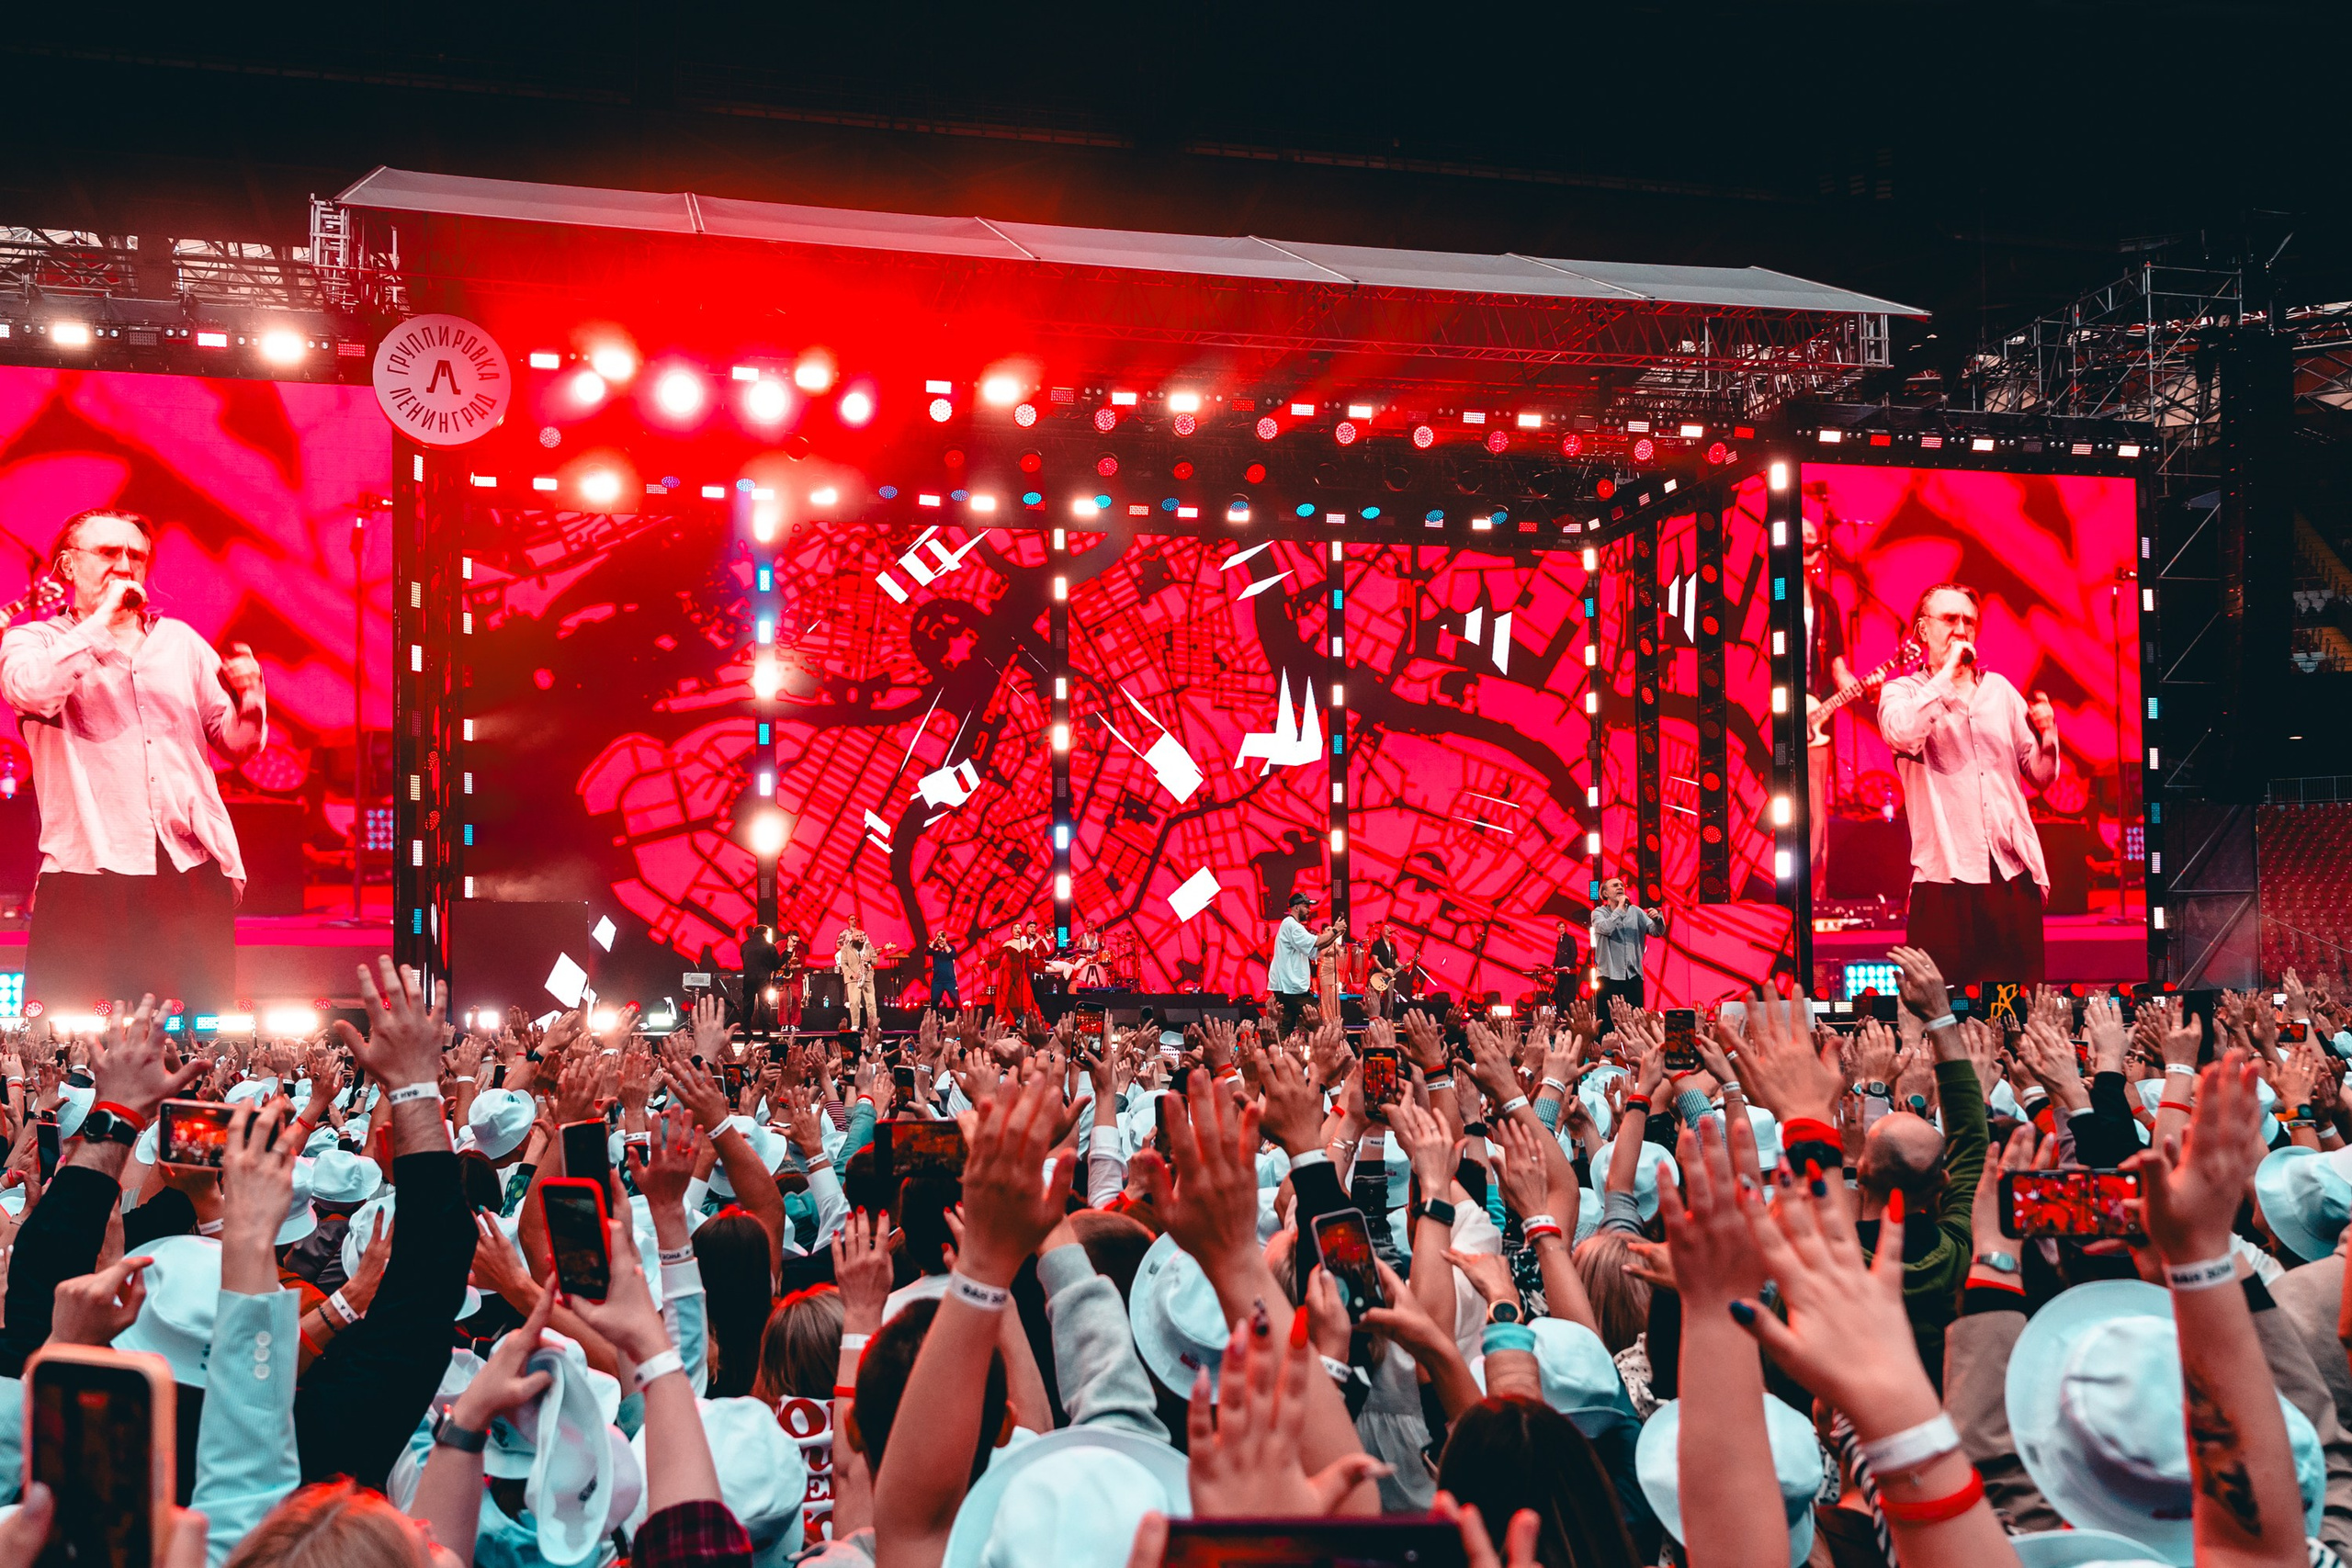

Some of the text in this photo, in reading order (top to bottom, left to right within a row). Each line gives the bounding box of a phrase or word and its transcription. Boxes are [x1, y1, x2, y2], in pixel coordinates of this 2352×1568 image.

[387, 325, 501, 381] ГРУППИРОВКА
[425, 359, 461, 395] Л
[389, 387, 497, 434] ЛЕНИНГРАД
